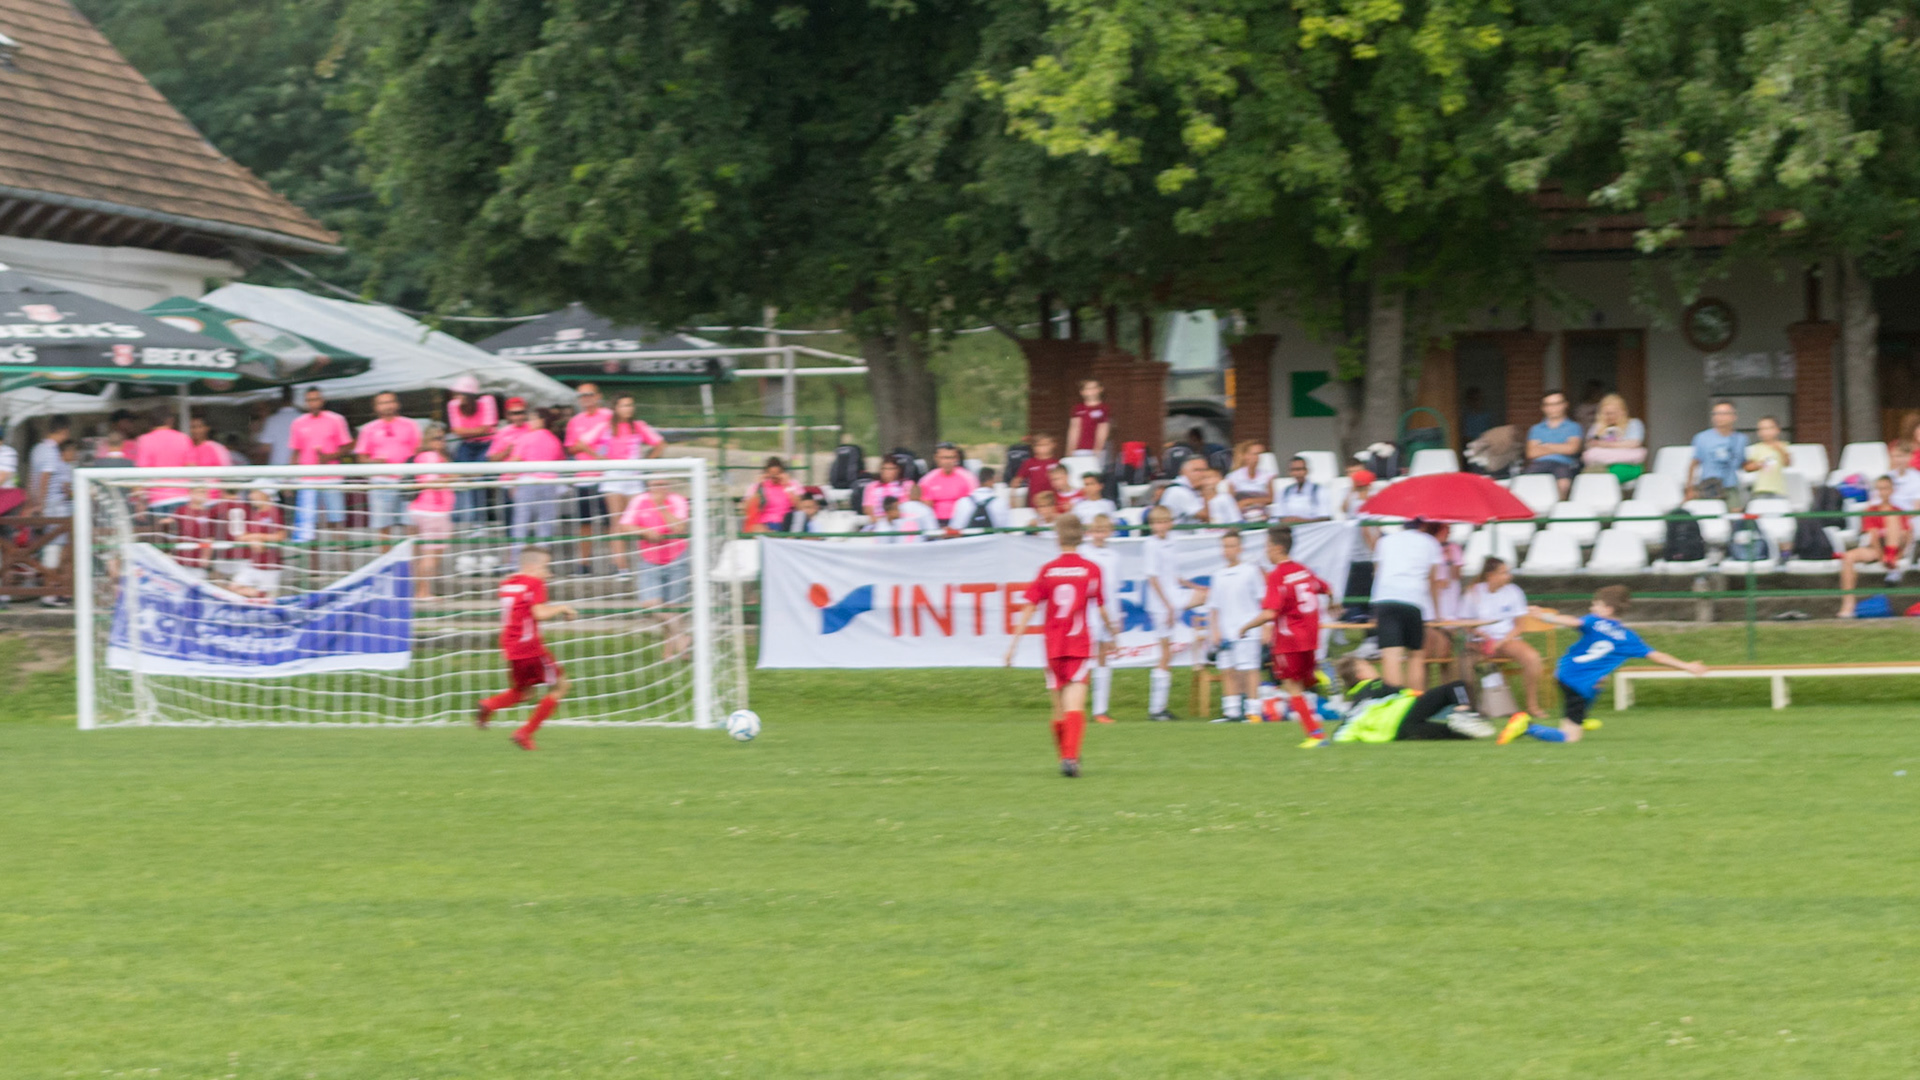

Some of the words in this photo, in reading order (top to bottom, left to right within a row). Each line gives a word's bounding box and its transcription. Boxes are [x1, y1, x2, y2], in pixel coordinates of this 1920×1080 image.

[142, 347, 237, 368] BECK'S
[888, 582, 1046, 636] INTE
[1053, 583, 1076, 618] 9
[1294, 582, 1318, 613] 5
[1572, 640, 1615, 663] 9
